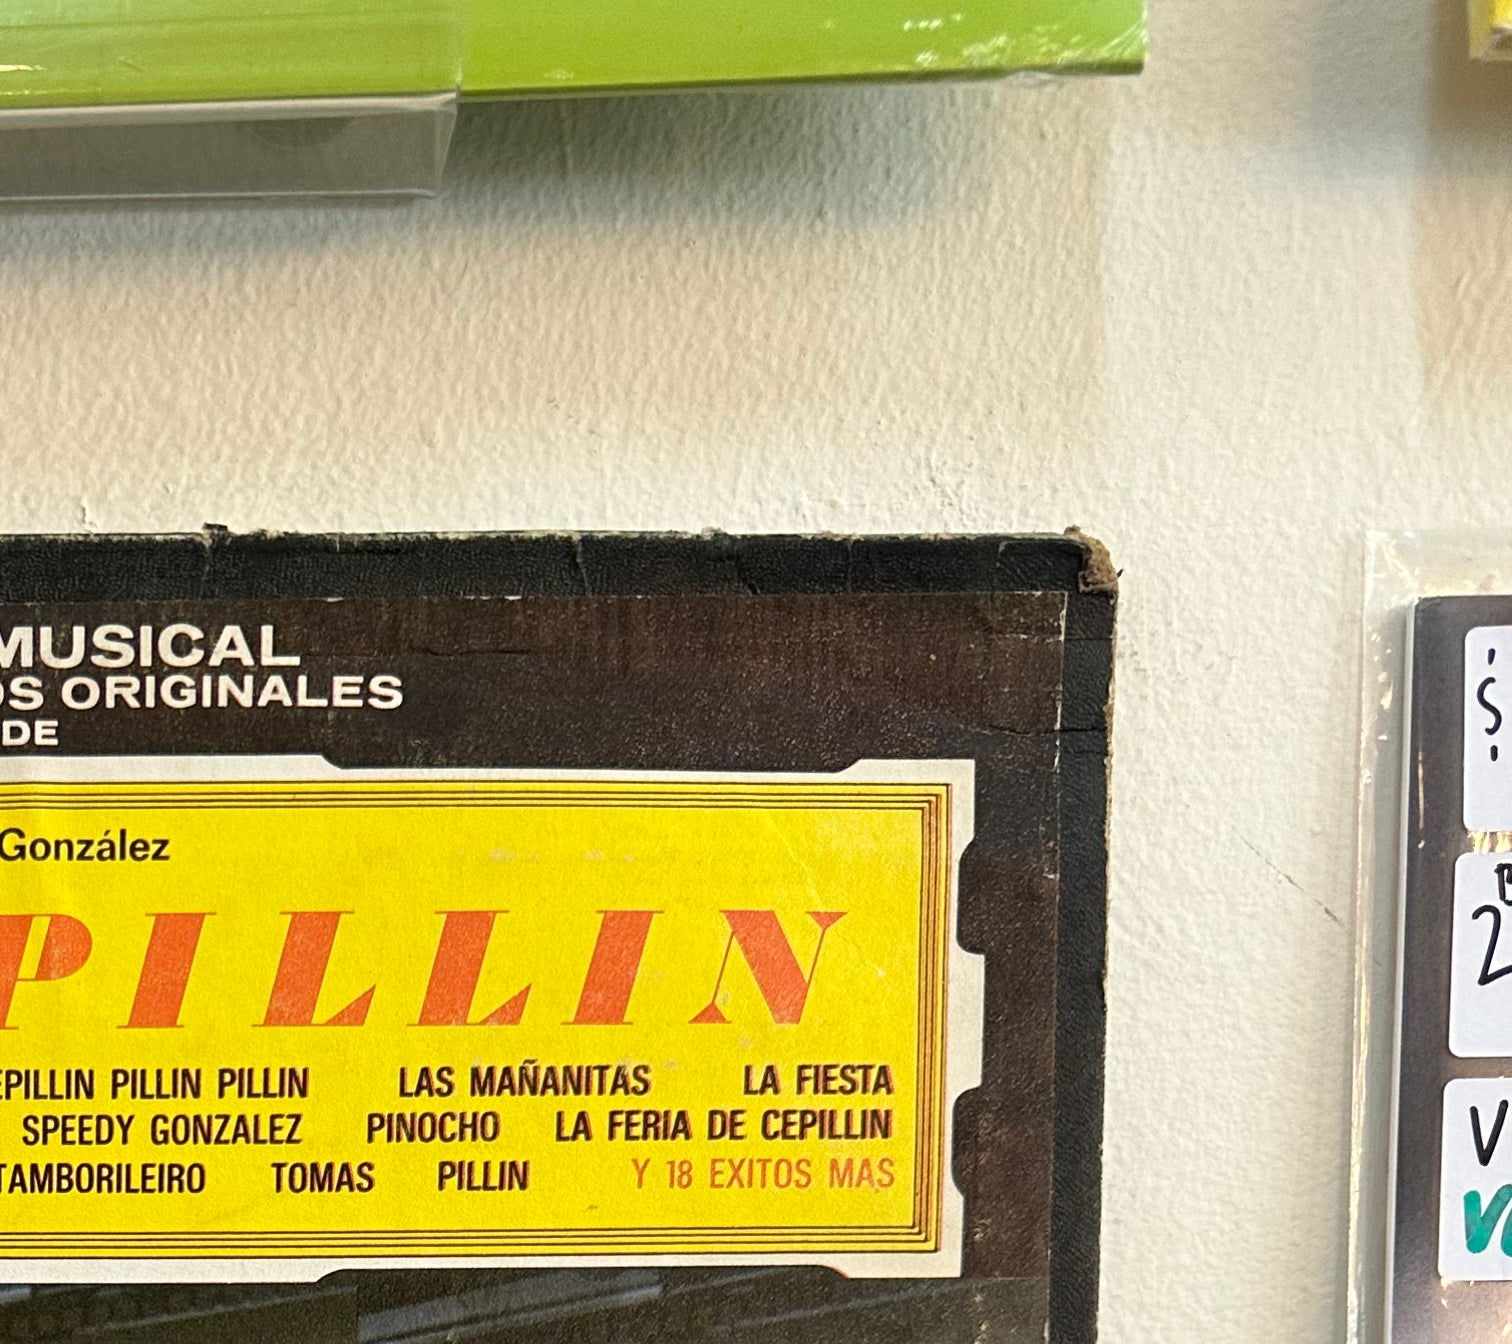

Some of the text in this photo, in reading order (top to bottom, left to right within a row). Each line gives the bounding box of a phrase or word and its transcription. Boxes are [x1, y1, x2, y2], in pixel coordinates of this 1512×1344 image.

[61, 674, 404, 709] ORIGINALES
[1, 719, 59, 747] DE
[111, 1067, 203, 1100] PILLIN
[218, 1066, 309, 1099] PILLIN
[399, 1065, 454, 1098] LAS
[469, 1058, 652, 1097] MAÑANITAS
[743, 1064, 780, 1096] LA
[796, 1063, 895, 1096] FIESTA
[21, 1113, 135, 1146] SPEEDY
[150, 1112, 303, 1145] GONZALEZ
[366, 1111, 501, 1143] PINOCHO
[554, 1110, 592, 1142] LA
[607, 1109, 690, 1142] FERIA
[707, 1109, 747, 1141] DE
[760, 1108, 894, 1141] CEPILLIN
[271, 1160, 376, 1193] TOMAS
[437, 1159, 530, 1192] PILLIN
[631, 1158, 653, 1189] Y
[666, 1158, 694, 1189] 18
[708, 1158, 813, 1189] EXITOS
[828, 1157, 896, 1189] MAS
